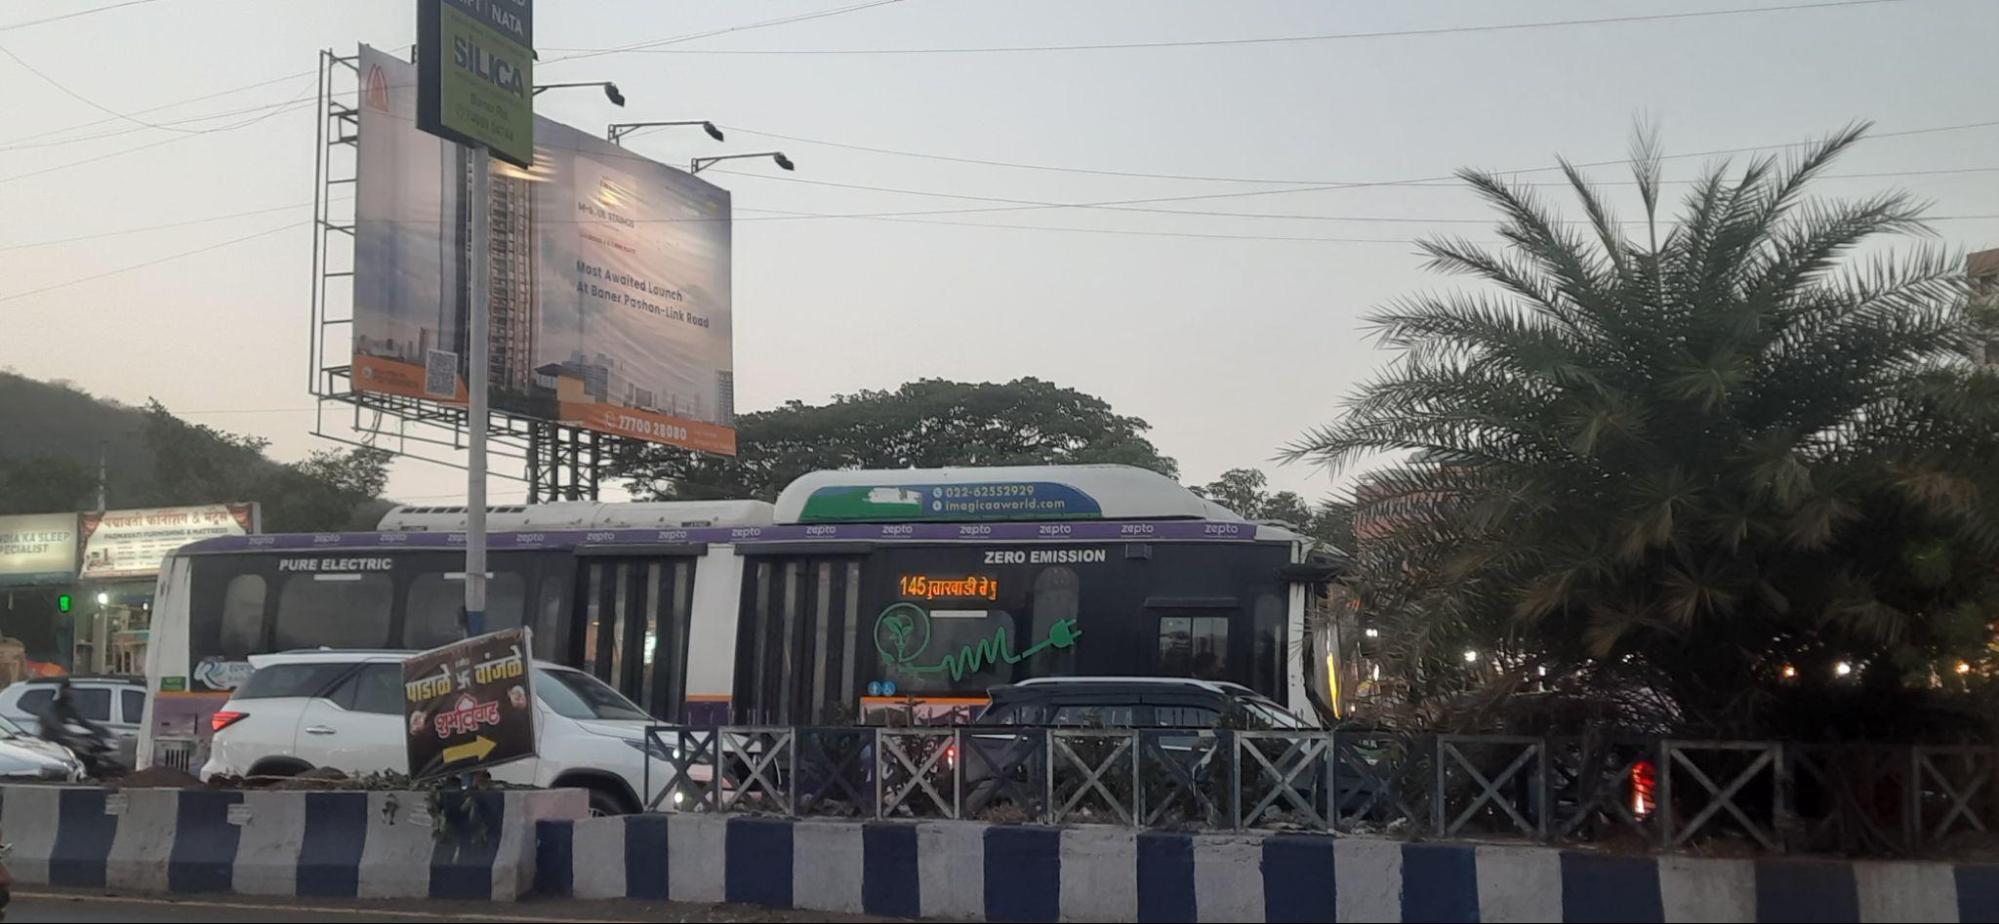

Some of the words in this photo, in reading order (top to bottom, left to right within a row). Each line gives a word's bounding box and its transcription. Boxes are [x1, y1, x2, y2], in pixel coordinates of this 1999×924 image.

[491, 4, 523, 35] NATA
[455, 35, 524, 99] SILICA
[577, 260, 602, 279] Most
[605, 269, 646, 292] Awaited
[648, 282, 683, 302] Launch
[577, 281, 589, 295] At
[591, 284, 621, 303] Baner
[624, 294, 685, 322] Pashan-Link
[687, 312, 710, 329] Road
[619, 415, 651, 433] 77700
[945, 485, 1035, 498] 022-62552929
[945, 499, 1065, 513] imagicaaworld.com
[658, 530, 687, 540] zepto
[731, 527, 761, 538] zepto
[806, 525, 837, 536] zepto
[882, 525, 913, 535] zepto
[959, 524, 991, 535] zepto
[1039, 524, 1072, 535] zepto
[1121, 524, 1154, 535] zepto
[1204, 524, 1239, 535] zepto
[39, 531, 70, 542] SLEEP
[314, 533, 341, 543] zepto
[380, 533, 407, 542] zepto
[516, 533, 545, 543] zepto
[586, 532, 615, 542] zepto
[984, 550, 1025, 564] ZERO
[1030, 549, 1106, 563] EMISSION
[279, 559, 317, 571] PURE
[321, 558, 393, 571] ELECTRIC
[900, 576, 926, 596] 145
